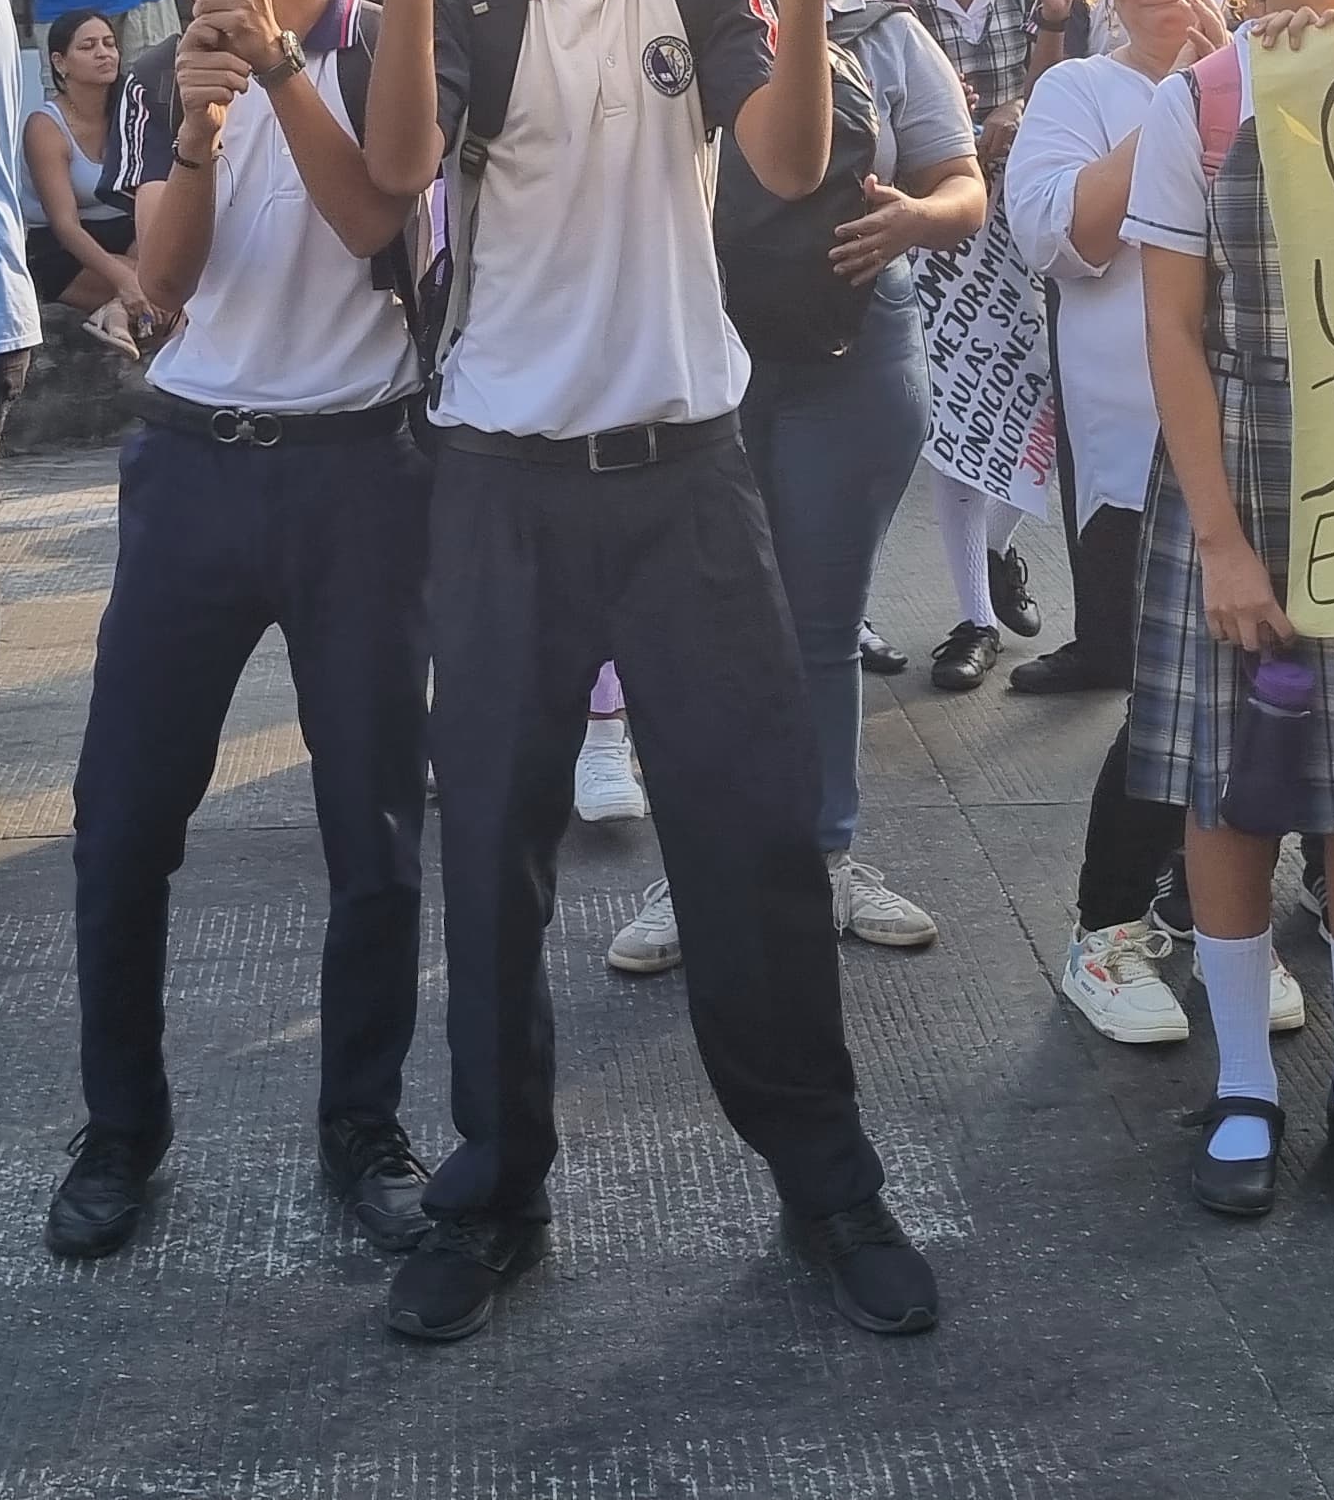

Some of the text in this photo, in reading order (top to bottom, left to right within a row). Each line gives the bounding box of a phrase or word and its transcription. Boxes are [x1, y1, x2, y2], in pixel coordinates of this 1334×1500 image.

[929, 190, 1011, 372] MEJORAMIEN
[934, 421, 960, 463] DE
[947, 338, 1000, 424] AULAS,
[988, 278, 1021, 328] SIN
[955, 311, 1045, 481] CONDICIONES,
[983, 370, 1051, 501] BIBLIOTECA.
